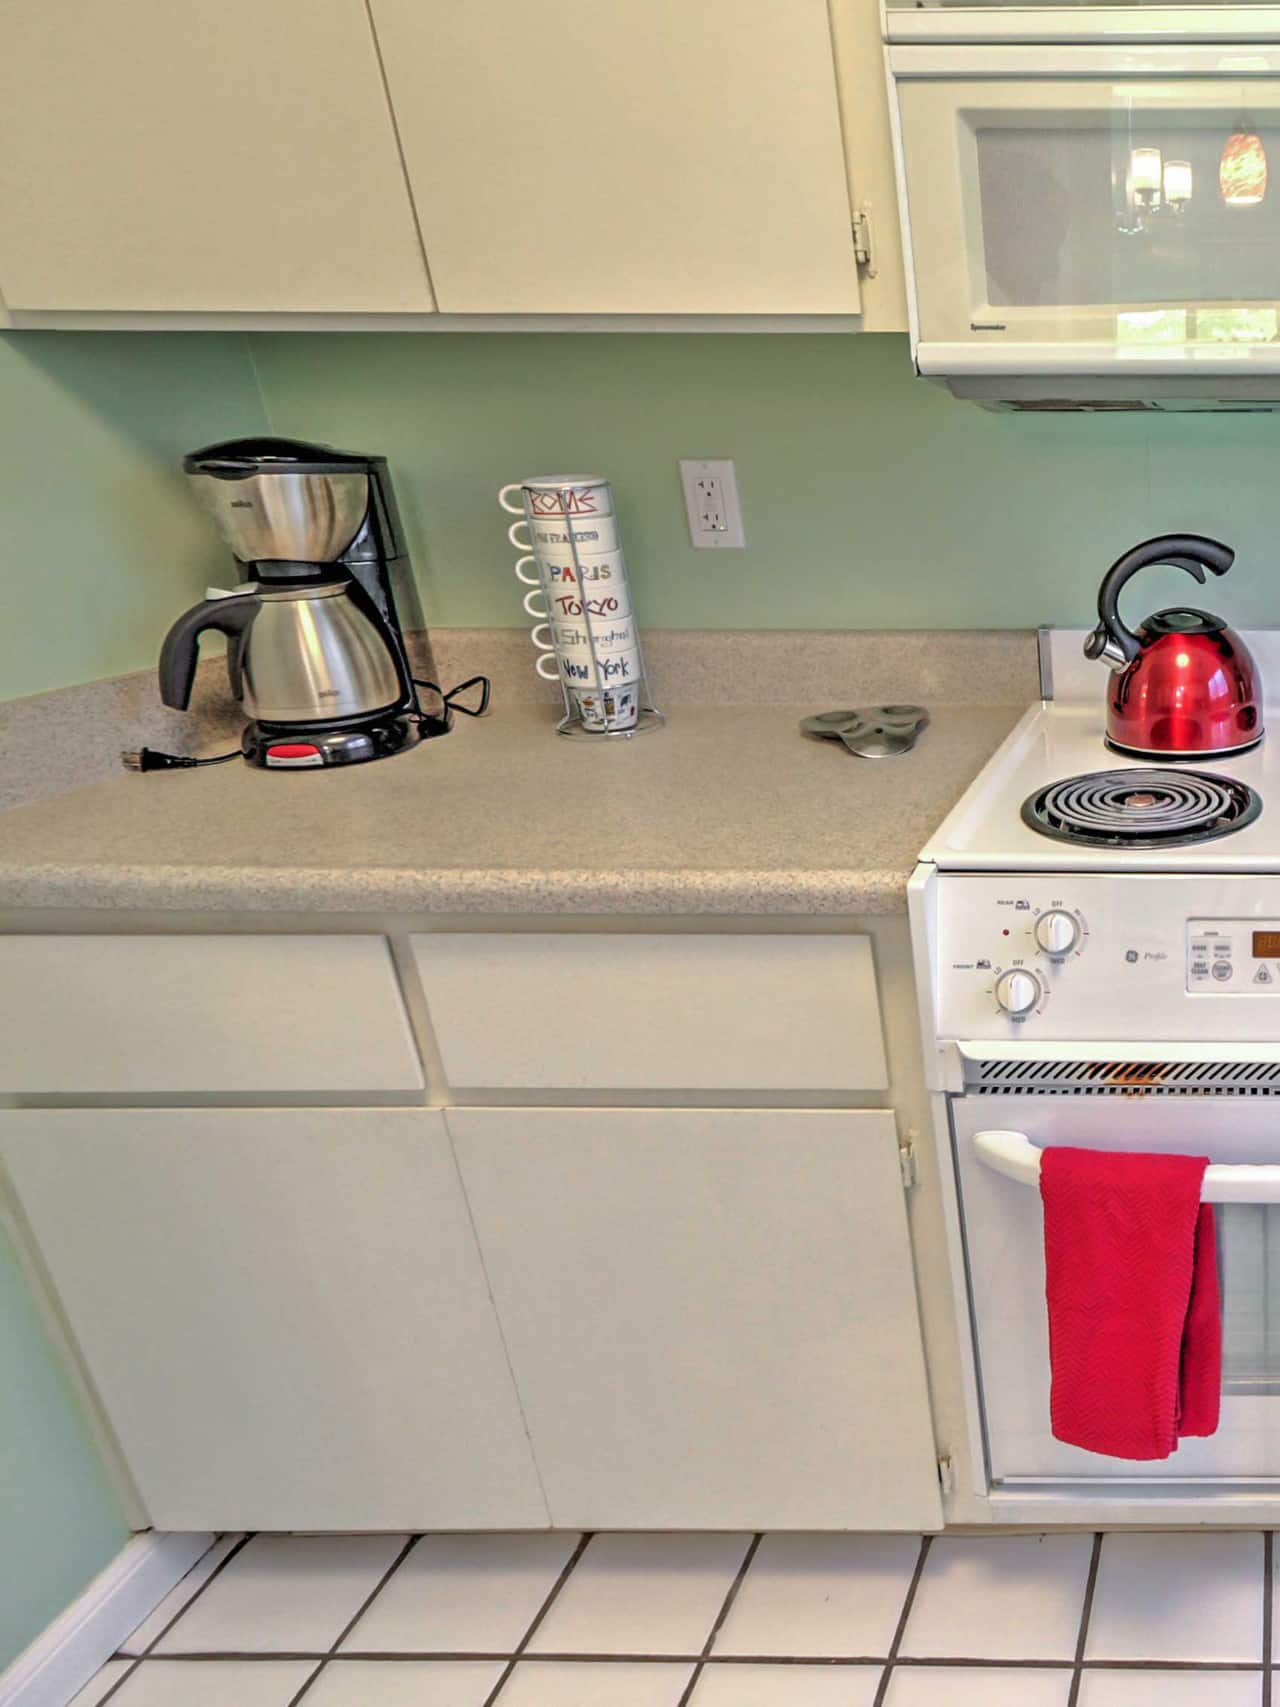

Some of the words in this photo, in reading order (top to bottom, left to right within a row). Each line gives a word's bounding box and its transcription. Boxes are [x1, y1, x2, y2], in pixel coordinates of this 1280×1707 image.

[529, 488, 597, 515] ROME
[549, 564, 612, 583] PARIS
[560, 627, 629, 648] Shnghai
[563, 658, 589, 679] New
[596, 656, 629, 681] York
